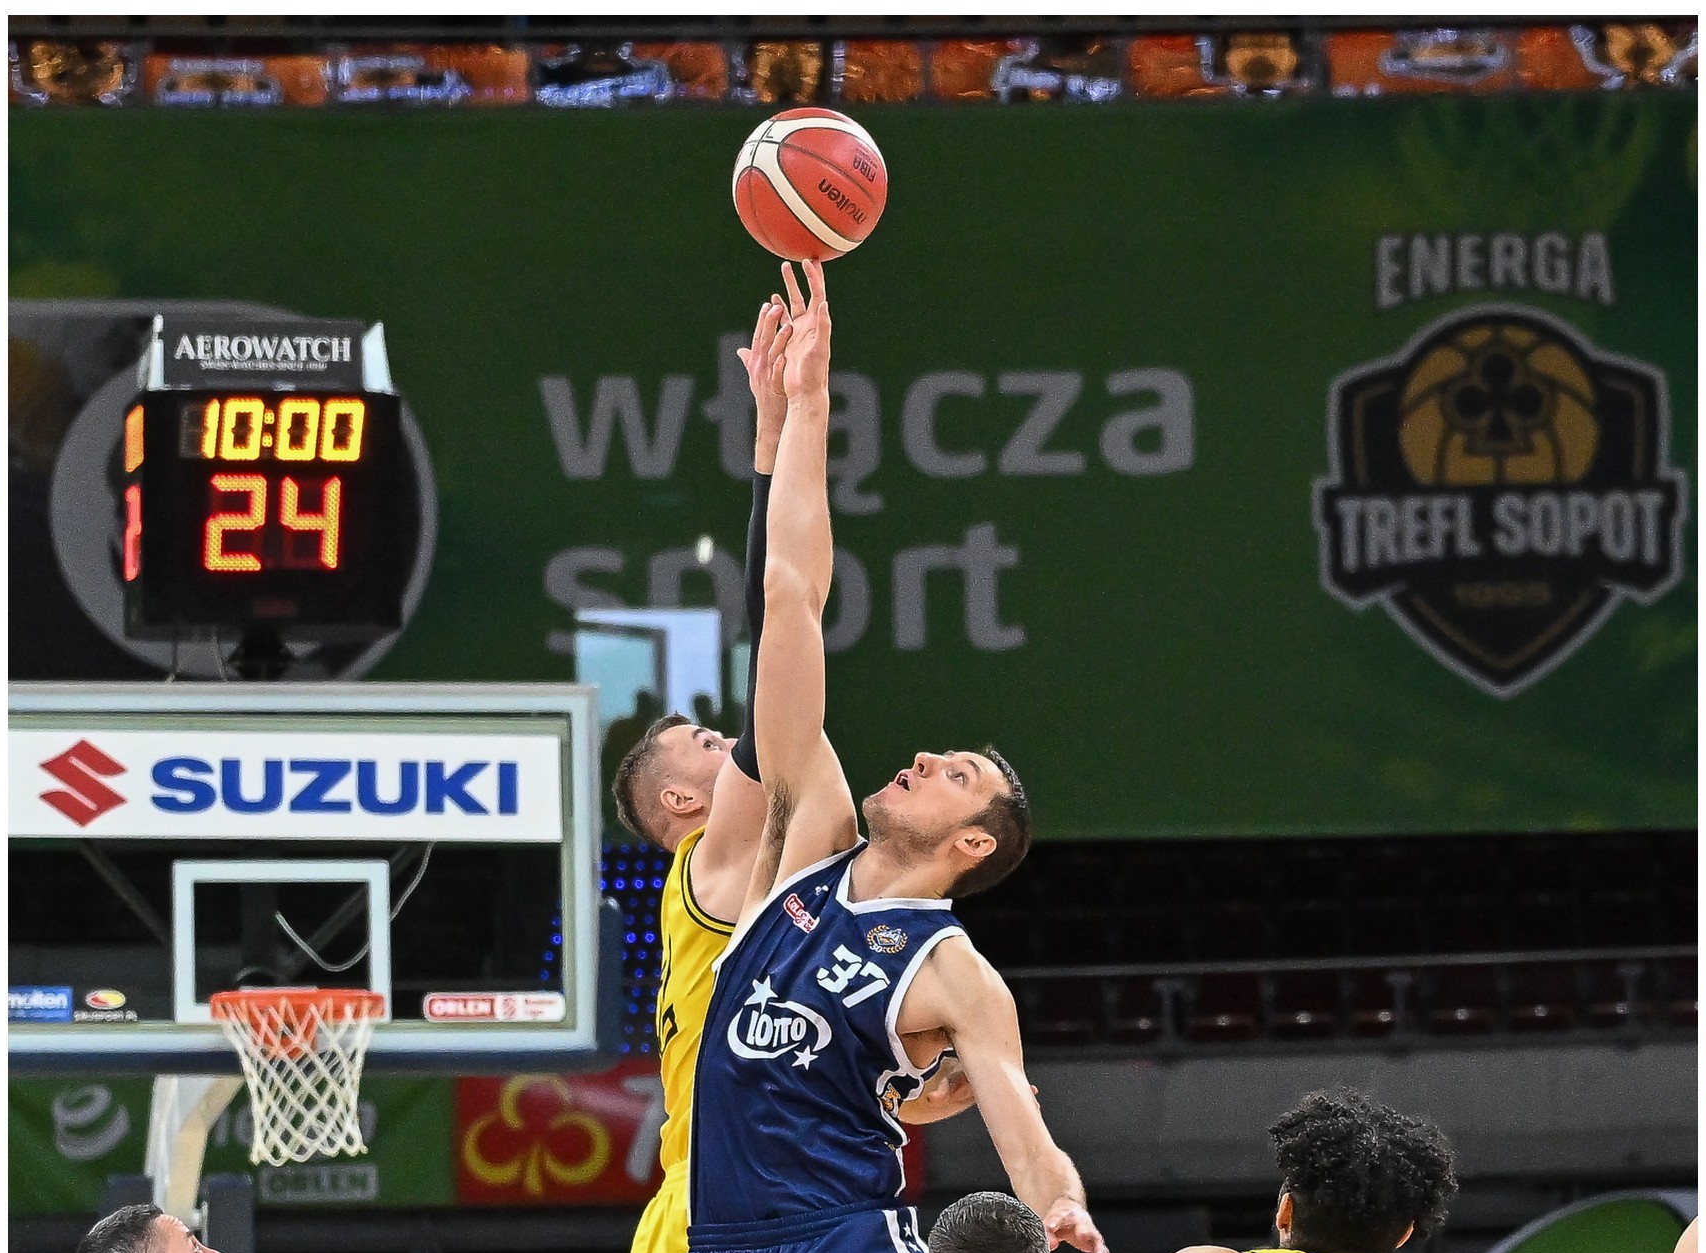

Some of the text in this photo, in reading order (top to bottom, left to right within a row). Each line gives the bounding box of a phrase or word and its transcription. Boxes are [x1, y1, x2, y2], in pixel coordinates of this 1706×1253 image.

[852, 156, 876, 183] FIBA
[818, 178, 866, 225] molten
[1374, 233, 1615, 310] ENERGA
[174, 334, 351, 362] AEROWATCH
[200, 398, 365, 462] 10:00
[204, 473, 342, 571] 24
[1338, 497, 1477, 572] TREFL
[1494, 490, 1664, 568] SOPOT
[149, 755, 519, 817] SUZUKI
[816, 944, 891, 1008] 37
[746, 1009, 807, 1048] LOTTO
